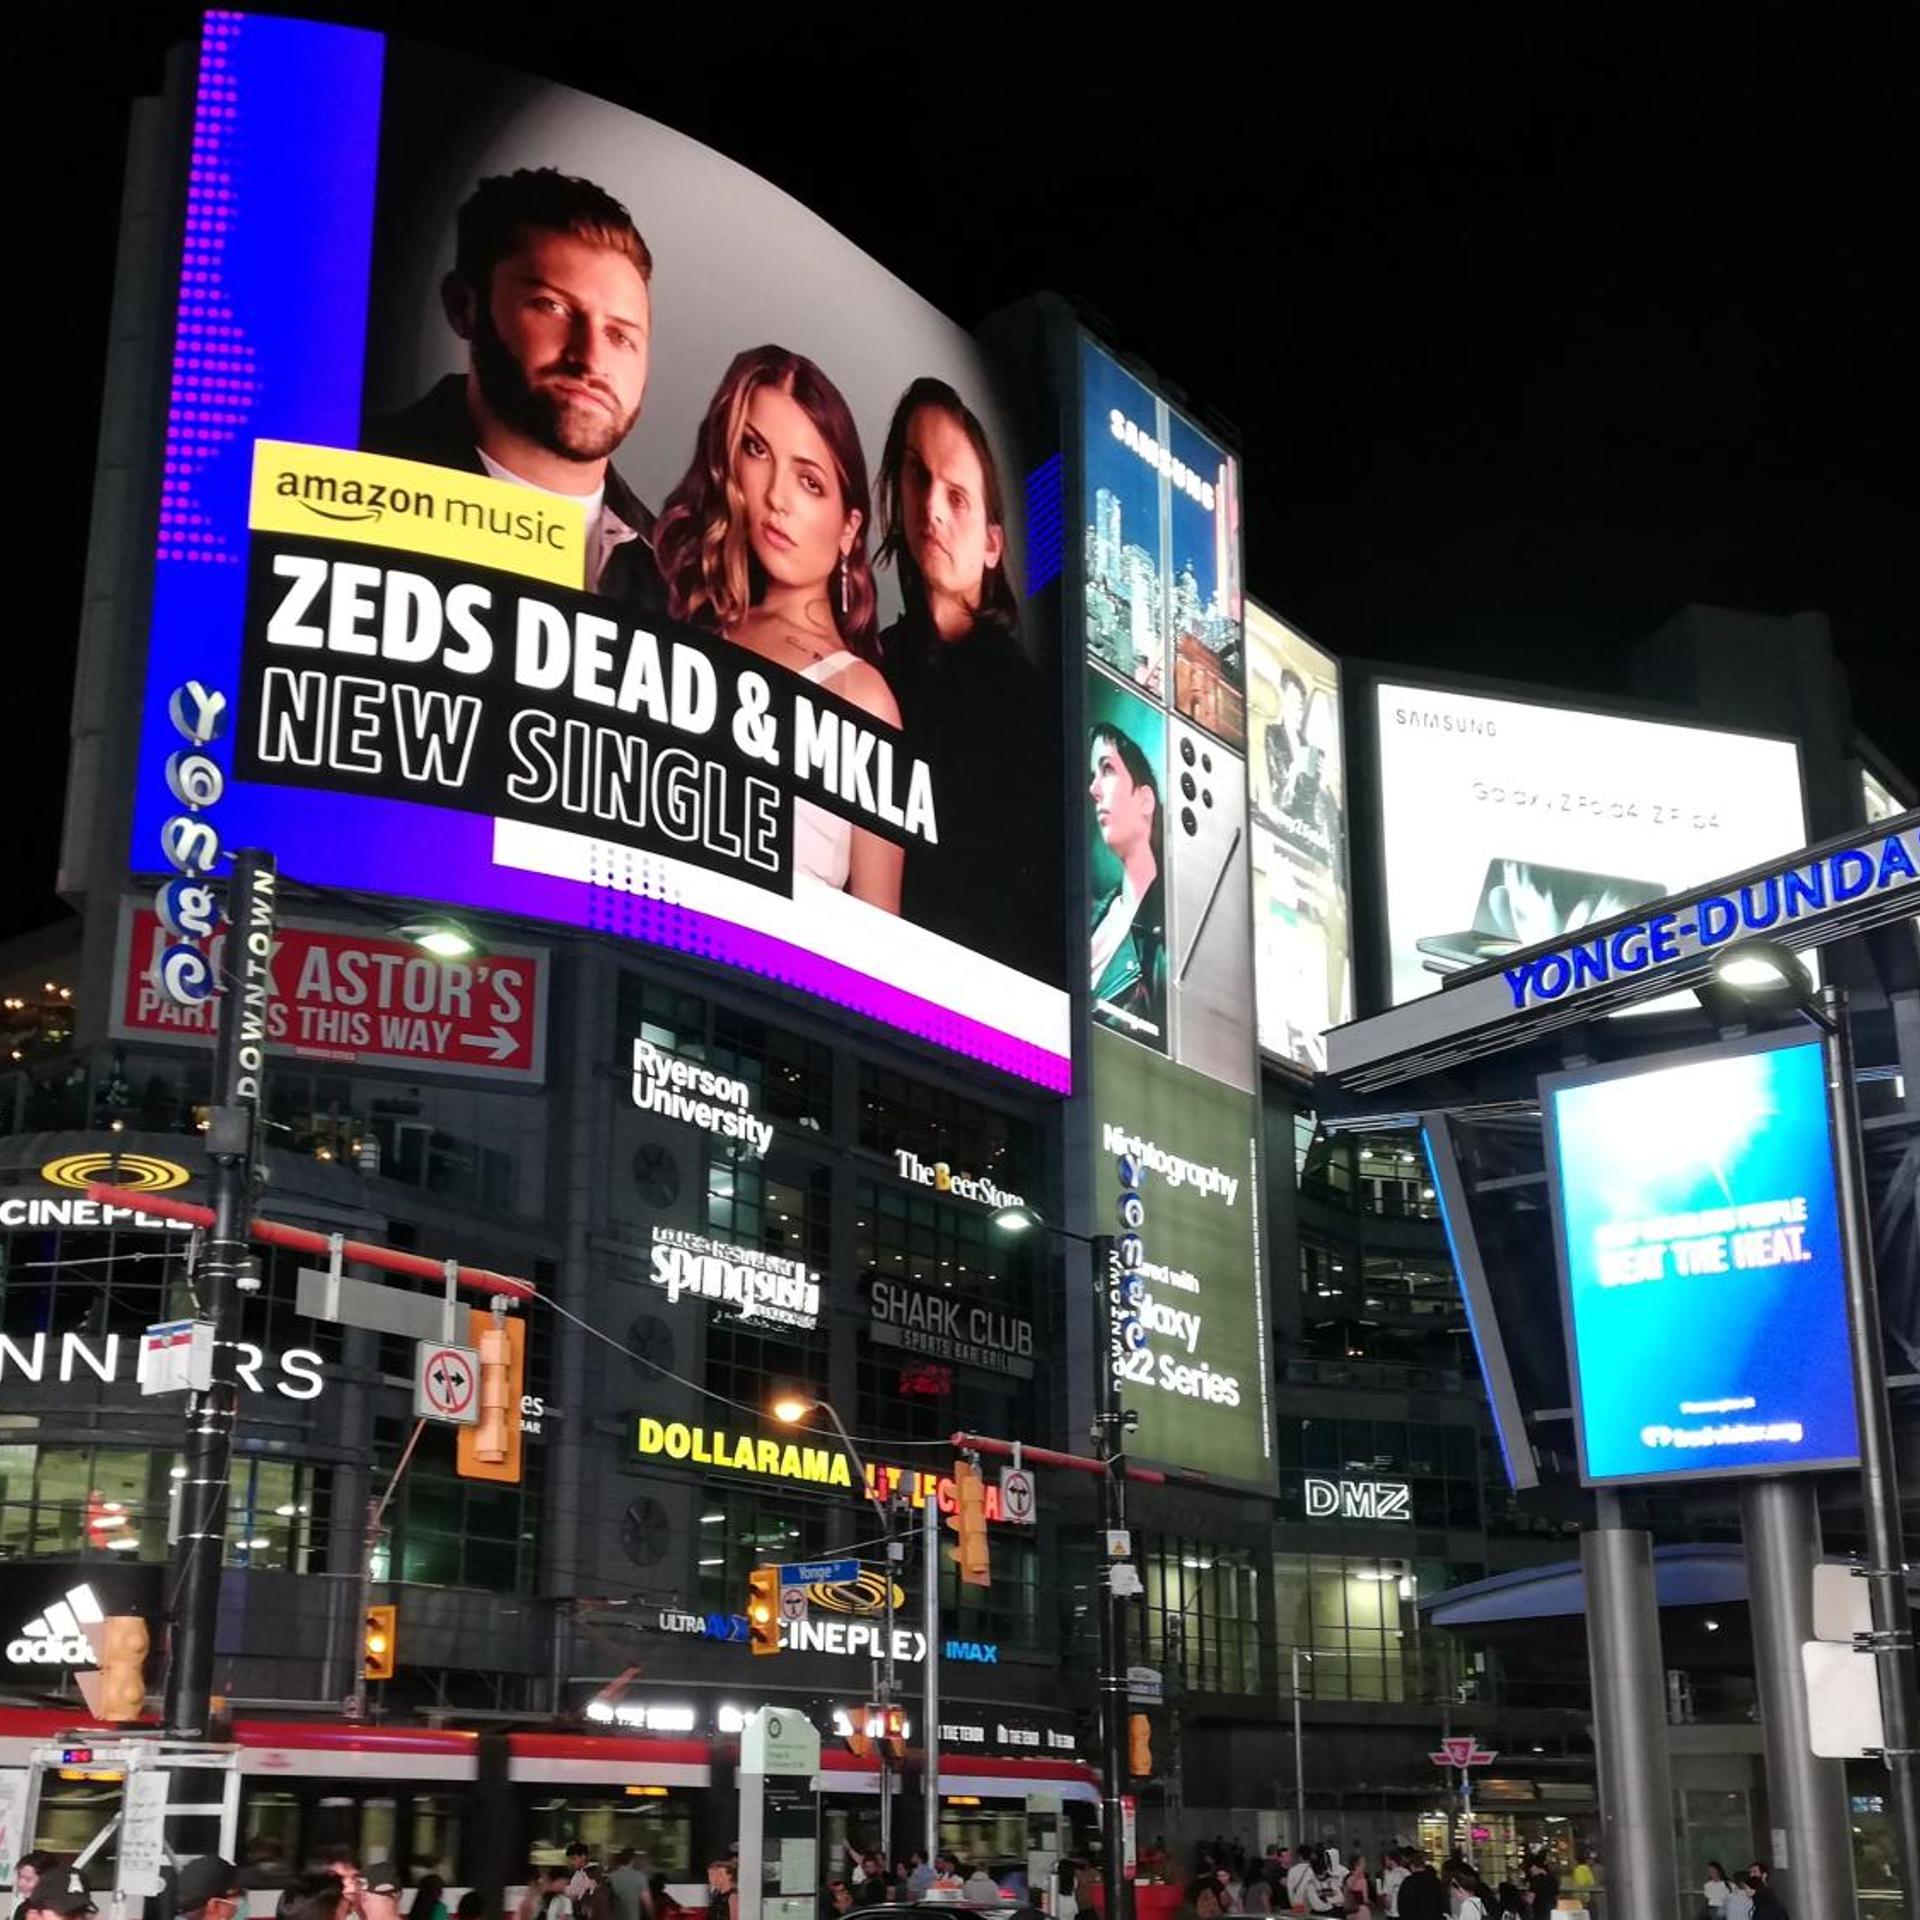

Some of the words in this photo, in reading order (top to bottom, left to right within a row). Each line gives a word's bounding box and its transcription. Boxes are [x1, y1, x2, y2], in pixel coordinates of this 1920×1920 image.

[277, 470, 435, 520] amazon
[446, 495, 565, 551] music
[267, 554, 494, 675] ZEDS
[515, 597, 718, 735] DEAD
[732, 671, 781, 766] &
[794, 695, 939, 845] MKLA
[1396, 709, 1497, 738] SAMSUNG
[258, 667, 482, 787] NEW
[507, 709, 781, 873] SINGLE
[1503, 830, 1920, 1009] YONGE-DUNDA
[237, 869, 275, 1099] DOWNTOWN
[295, 946, 523, 1025] ASTOR'S
[297, 1007, 372, 1047] THIS
[380, 1019, 453, 1054] WAY
[633, 1037, 749, 1108] Ryerson
[632, 1071, 774, 1153] University
[895, 1148, 934, 1187] The
[934, 1161, 980, 1201] Beer
[0, 1198, 204, 1230] CINEPL
[871, 1281, 961, 1340] SHARK
[970, 1308, 1034, 1357] CLUB
[1158, 1354, 1241, 1407] Series
[638, 1417, 851, 1488] DOLLARAMA
[1304, 1478, 1411, 1521] DMZ
[946, 1641, 997, 1664] IMAX
